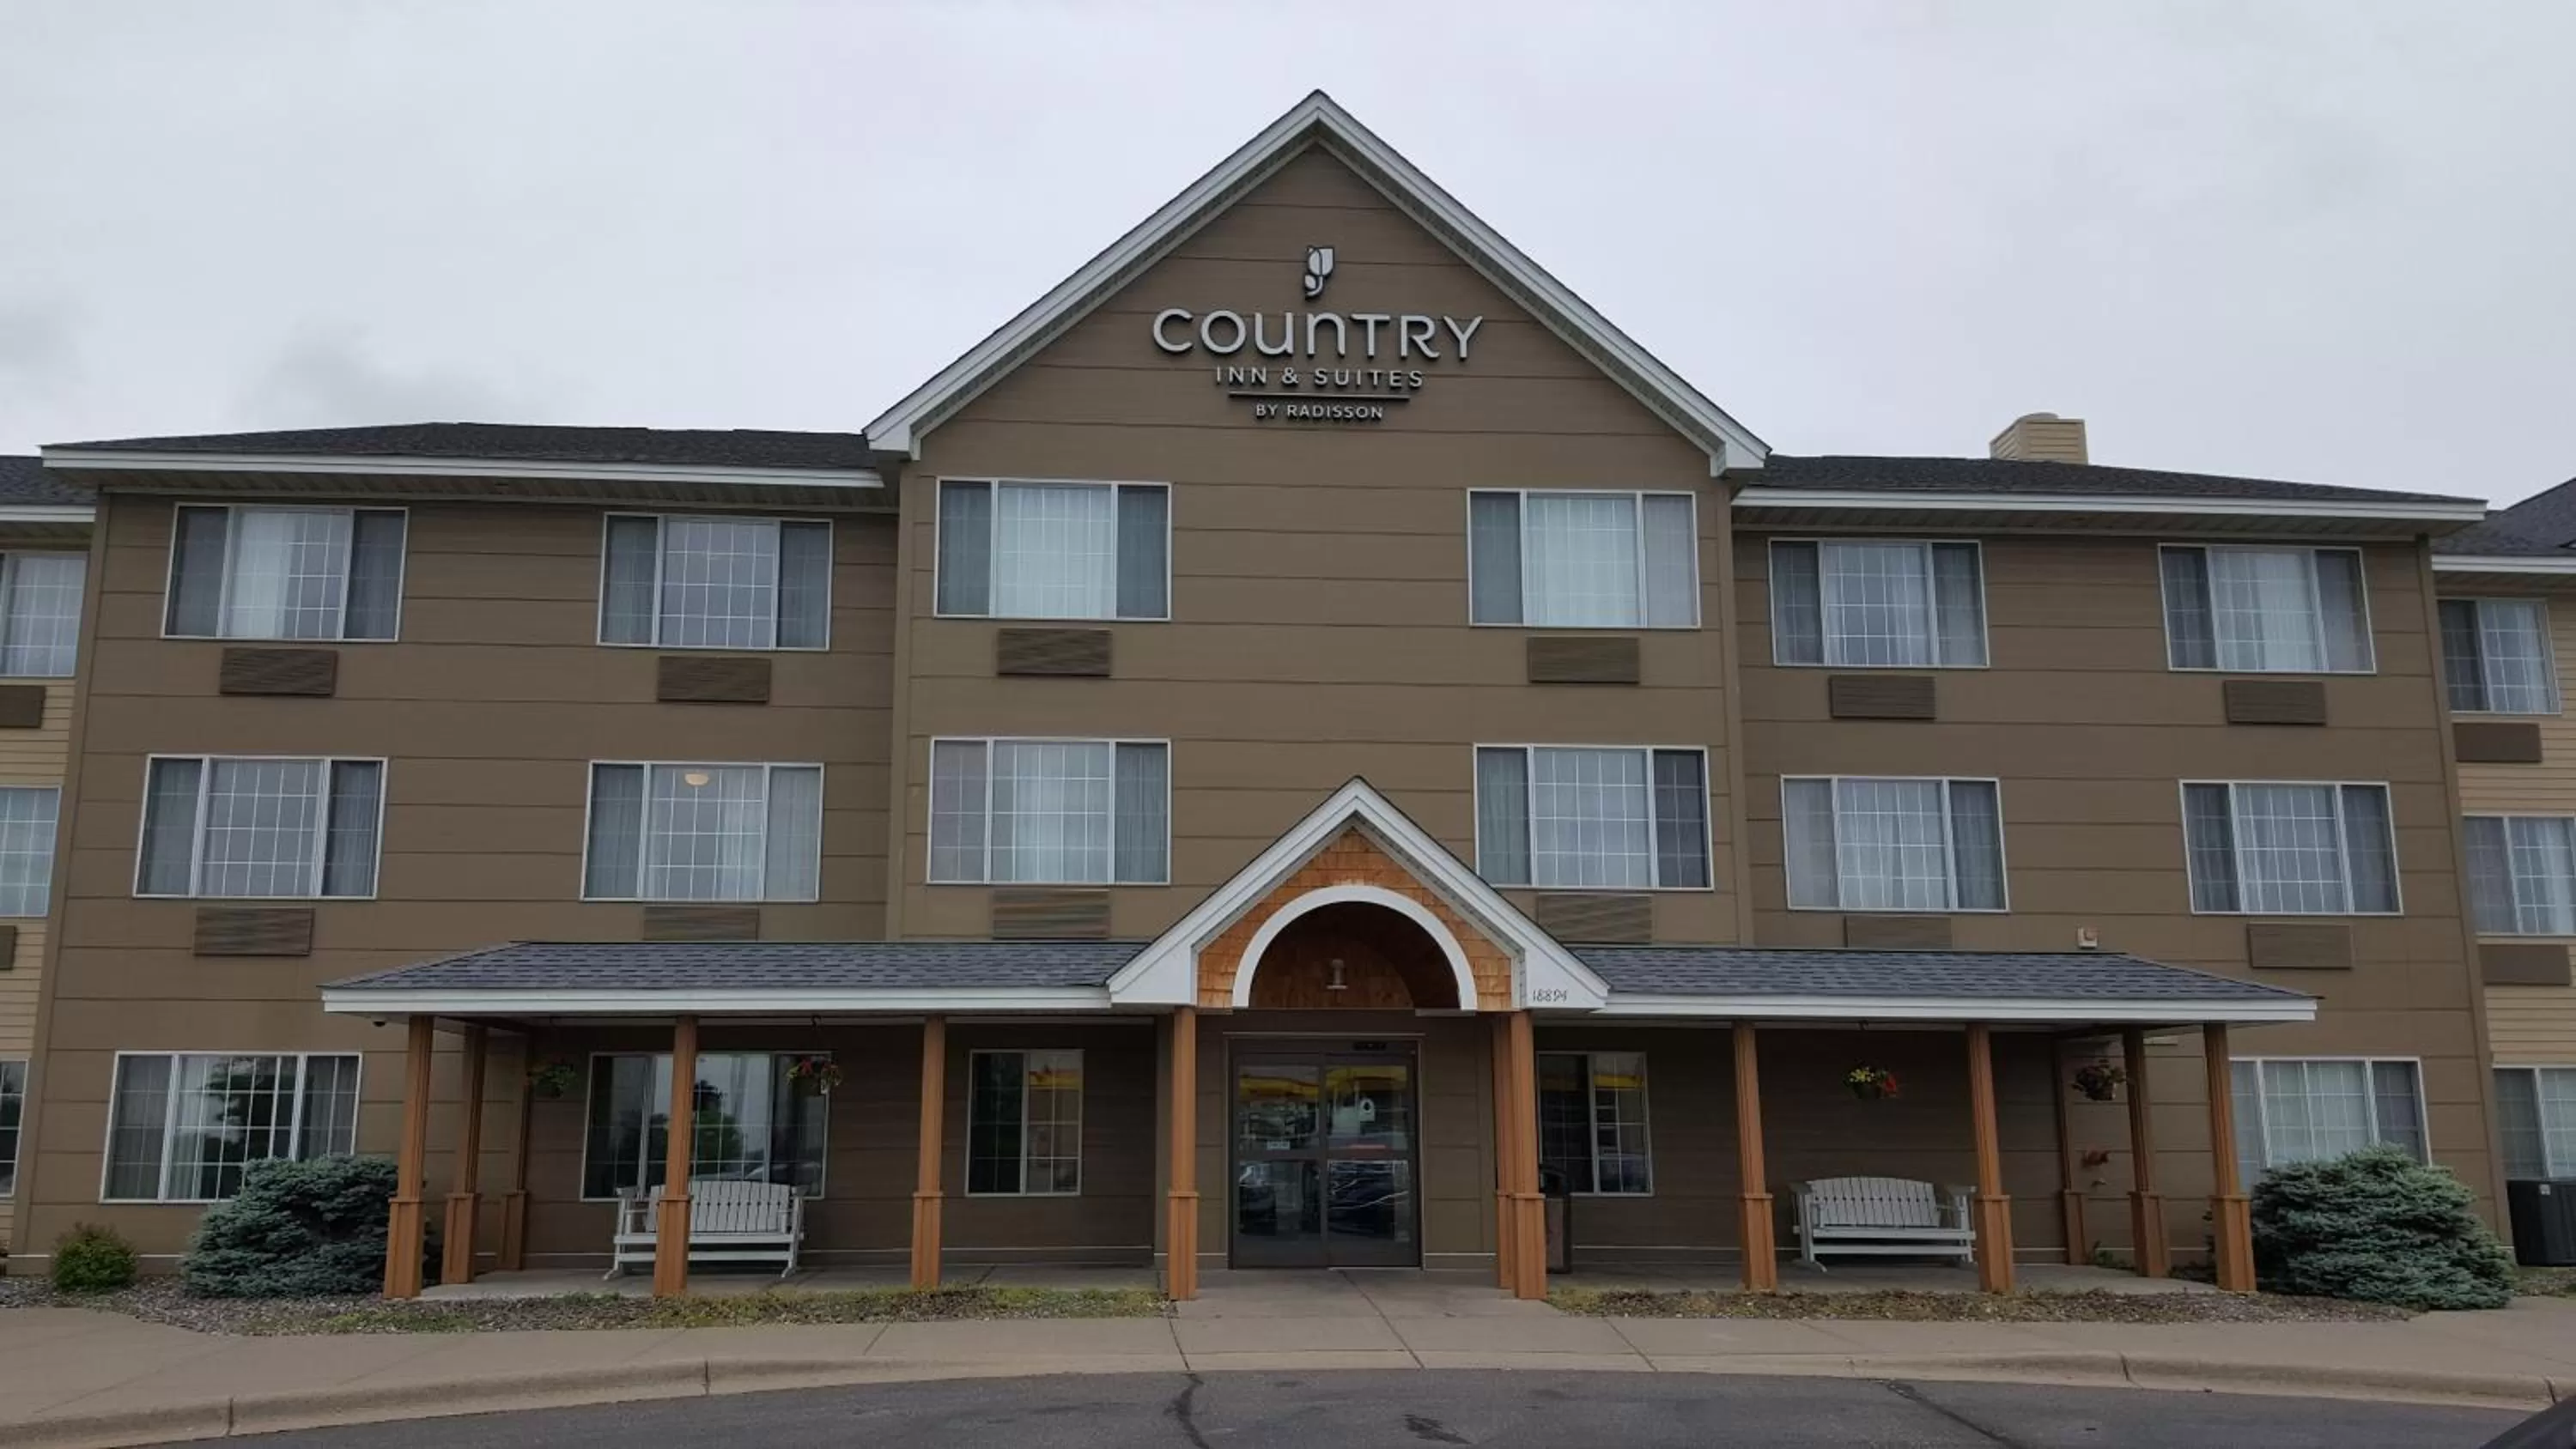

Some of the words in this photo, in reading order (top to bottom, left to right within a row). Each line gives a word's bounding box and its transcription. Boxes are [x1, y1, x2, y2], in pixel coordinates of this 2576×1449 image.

[1152, 307, 1484, 361] COUNTRY
[1215, 366, 1267, 385] INN
[1281, 367, 1300, 385] &
[1314, 367, 1425, 389] SUITES
[1255, 403, 1279, 418] BY
[1286, 404, 1385, 420] RADISSON
